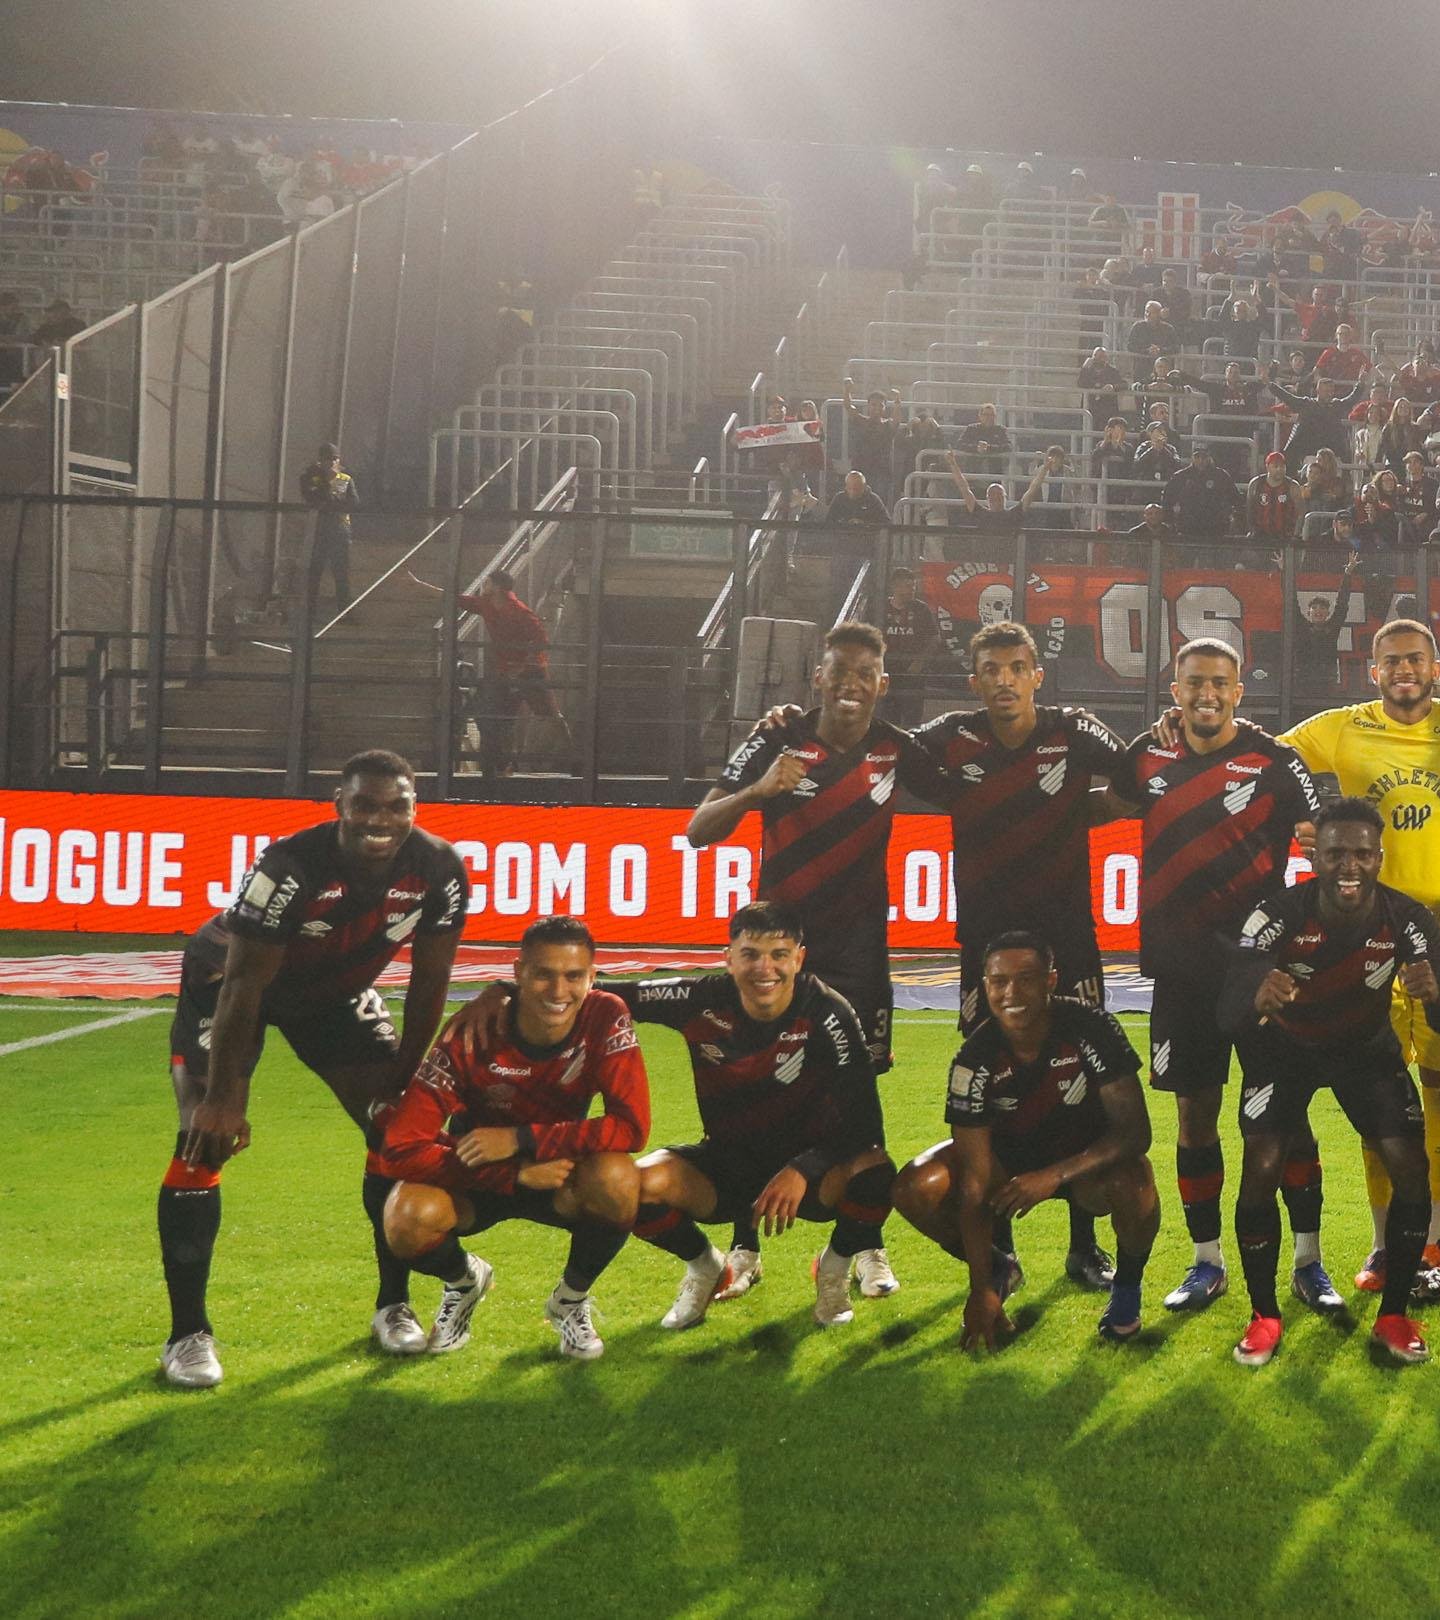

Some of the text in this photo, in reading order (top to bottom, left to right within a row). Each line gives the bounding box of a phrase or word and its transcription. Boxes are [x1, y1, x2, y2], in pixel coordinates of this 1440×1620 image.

[1100, 584, 1245, 680] OS
[1077, 718, 1118, 751] HAVAN
[1353, 717, 1387, 730] Copacol
[731, 737, 767, 781] HAVAN
[783, 745, 819, 760] Copacol
[1037, 746, 1069, 755] Copaco
[1147, 744, 1179, 760] Copacol
[1226, 761, 1263, 775] Copacol
[1288, 758, 1320, 812] HAVAN
[0, 817, 184, 907] OGUE
[462, 841, 585, 917] COM
[609, 845, 646, 917] O
[264, 875, 300, 929] HAVAN
[638, 987, 691, 1003] HAVAN
[823, 1013, 851, 1067] HAVAN
[489, 1063, 532, 1077] Copacol
[971, 1065, 990, 1113] HAVAN
